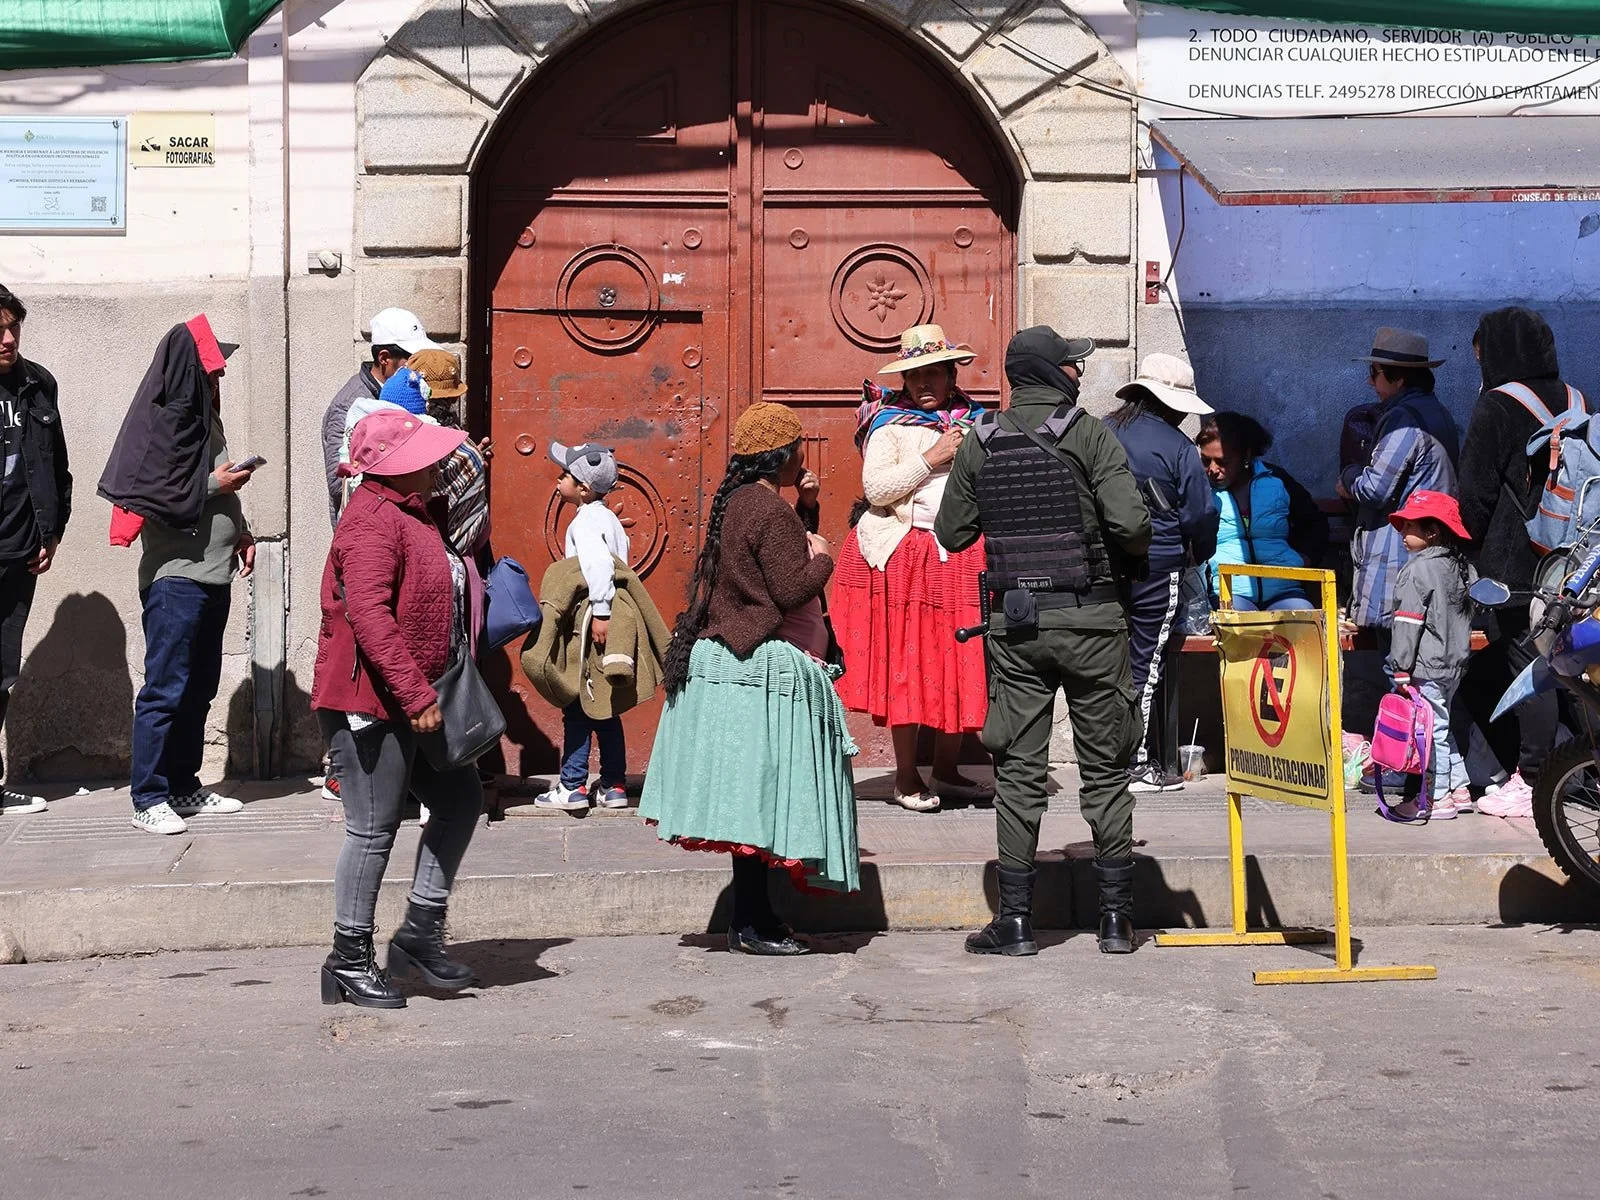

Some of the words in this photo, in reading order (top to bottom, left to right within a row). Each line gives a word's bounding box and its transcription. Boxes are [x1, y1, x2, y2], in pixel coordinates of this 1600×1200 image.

[1189, 29, 1202, 43] 2.
[1210, 29, 1257, 43] TODO
[1268, 29, 1371, 45] CIUDADANO,
[1383, 29, 1462, 44] SERVIDOR
[1473, 30, 1494, 46] (A)
[1189, 47, 1284, 61] DENUNCIAR
[1288, 47, 1378, 63] CUALQUIER
[1383, 48, 1440, 62] HECHO
[1444, 48, 1544, 62] ESTIPULADO
[1550, 49, 1569, 62] EN
[1575, 49, 1591, 62] EL
[1189, 84, 1282, 99] DENUNCIAS
[1286, 85, 1324, 99] TELF.
[1329, 85, 1396, 99] 2495278
[1400, 82, 1487, 99] DIRECCIÓN
[1492, 85, 1600, 100] DEPARTAMEN
[169, 136, 209, 148] SACAR
[165, 151, 213, 164] FOTOGRAFIAS
[1511, 192, 1551, 202] CONSEJO
[1554, 193, 1565, 201] DE
[1230, 748, 1272, 779] PROHIBIDO
[1272, 756, 1326, 789] ESTACIONAR
